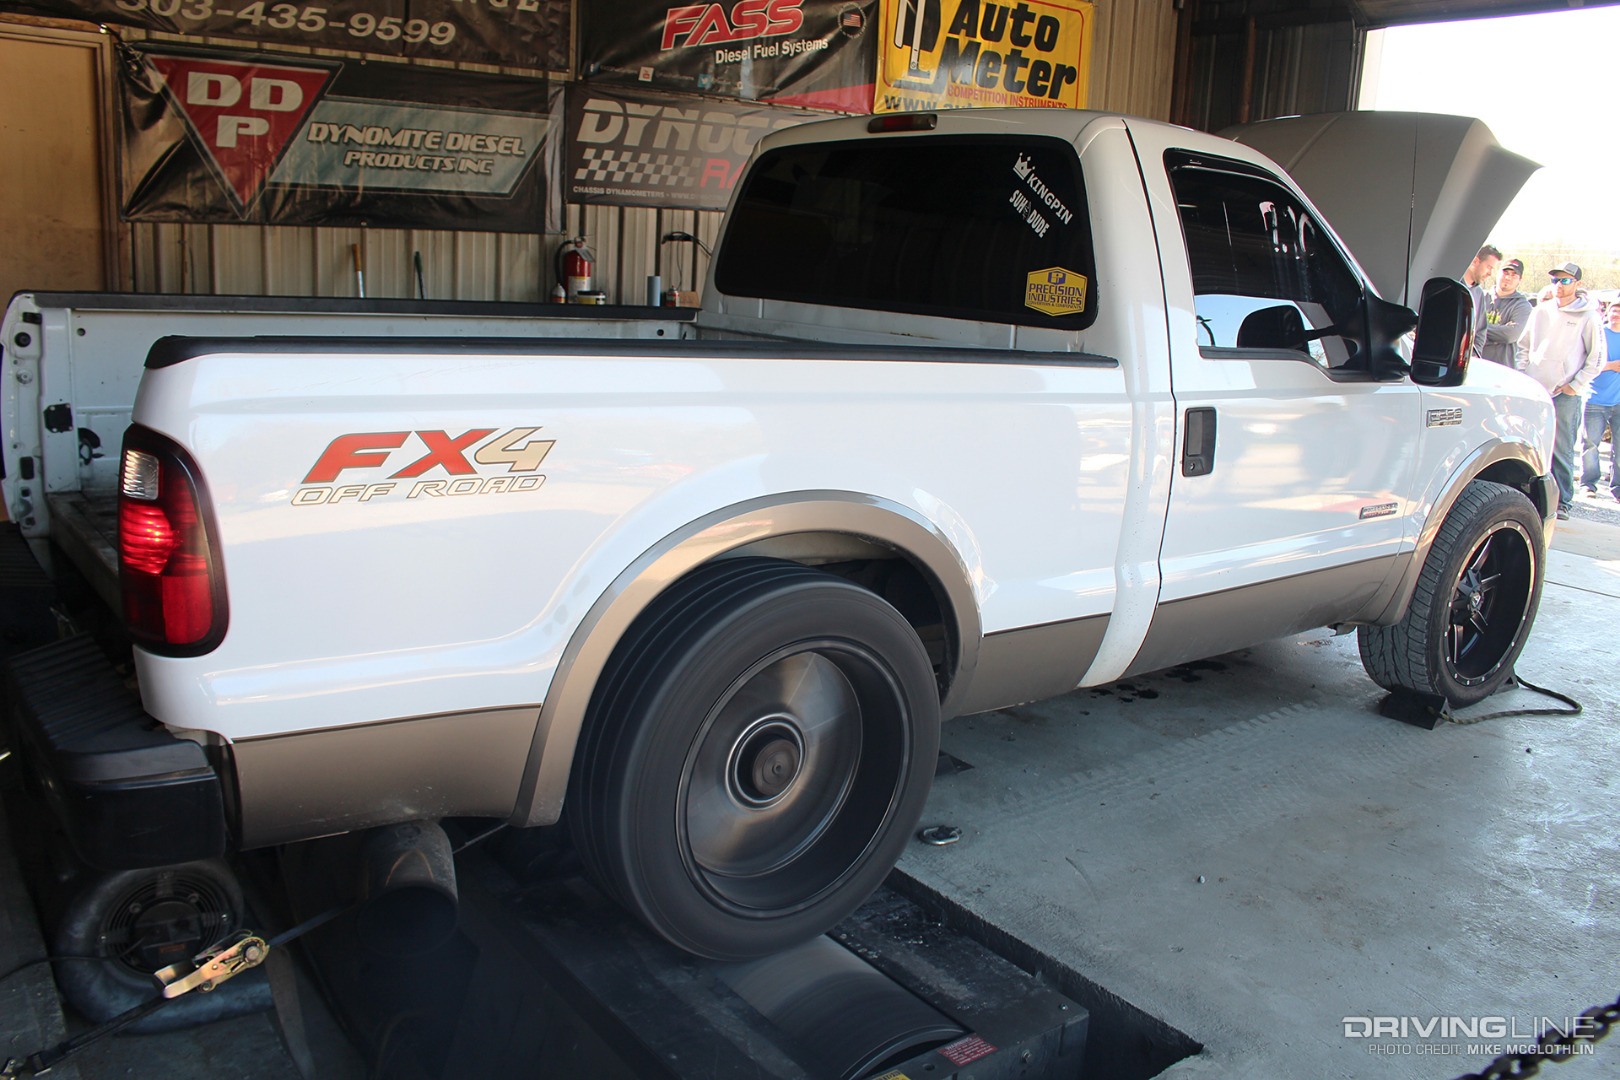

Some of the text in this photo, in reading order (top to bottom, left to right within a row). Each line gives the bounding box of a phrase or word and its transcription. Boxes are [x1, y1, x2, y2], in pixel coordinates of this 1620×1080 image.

[661, 0, 803, 50] FASS
[948, 0, 1060, 52] Auto
[715, 38, 828, 64] Diesel Fuel Systems
[938, 36, 1077, 99] Meter
[948, 85, 1067, 108] COMPETITION INSTRUMENTS
[306, 121, 525, 156] DYNOMITE DIESEL
[576, 98, 803, 156] DYNOC
[344, 151, 494, 174] PRODUCTS INC
[573, 186, 604, 195] CHASSIS
[606, 188, 665, 198] DYNAMOMETERS
[1027, 173, 1073, 225] KINGPIN
[1009, 189, 1050, 238] SUH DUDE
[1028, 293, 1082, 305] INDUSTRIES
[1029, 283, 1082, 297] PRECISION
[301, 426, 557, 484] FX4
[291, 474, 546, 506] OFF ROAD
